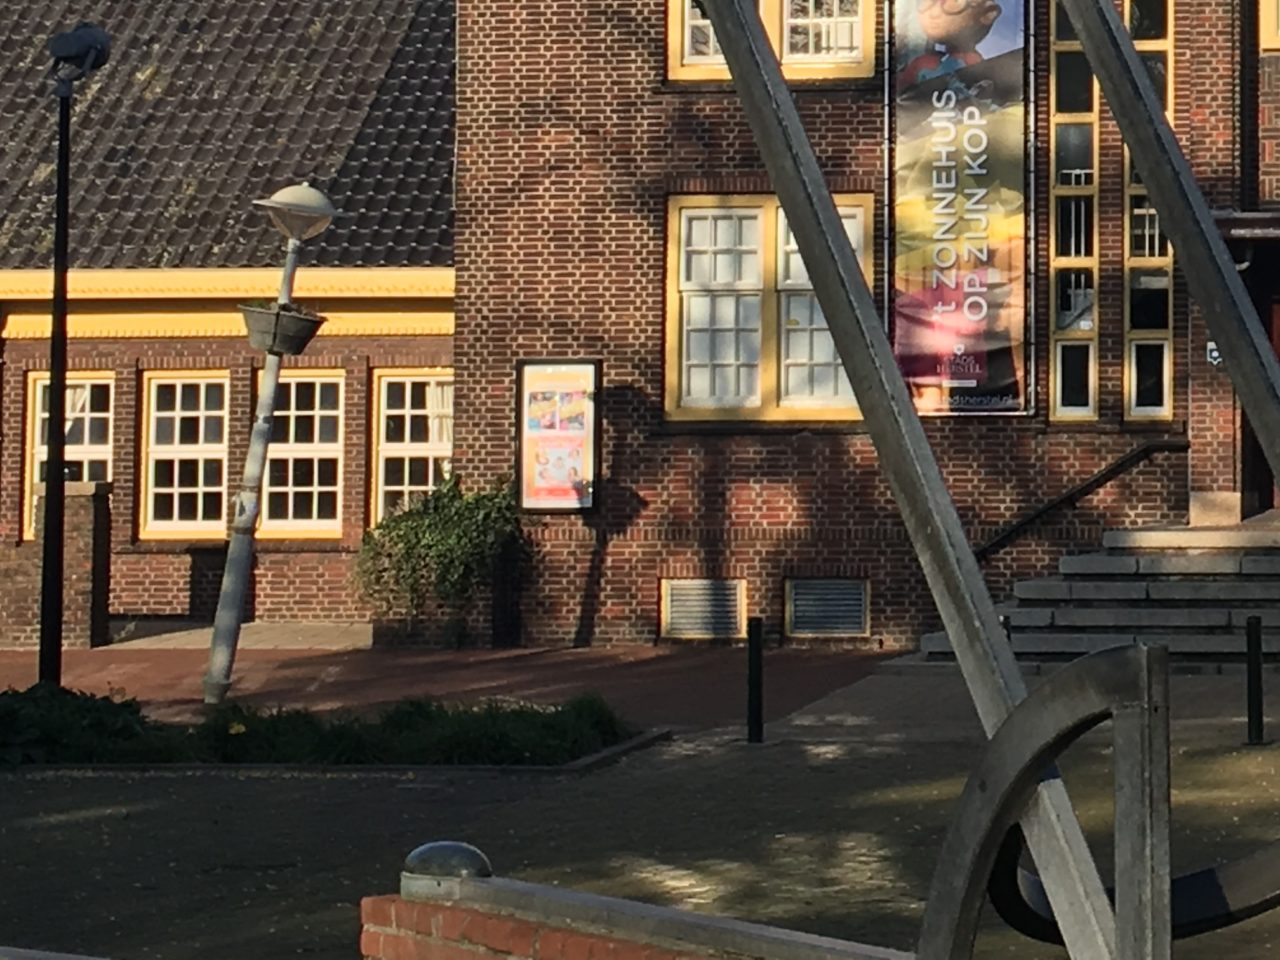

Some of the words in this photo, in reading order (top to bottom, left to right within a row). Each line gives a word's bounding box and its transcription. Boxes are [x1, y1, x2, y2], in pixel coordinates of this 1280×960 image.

[963, 105, 988, 175] KOP
[932, 89, 957, 289] ZONNEHUIS
[963, 187, 989, 262] ZIJN
[963, 273, 988, 322] OP
